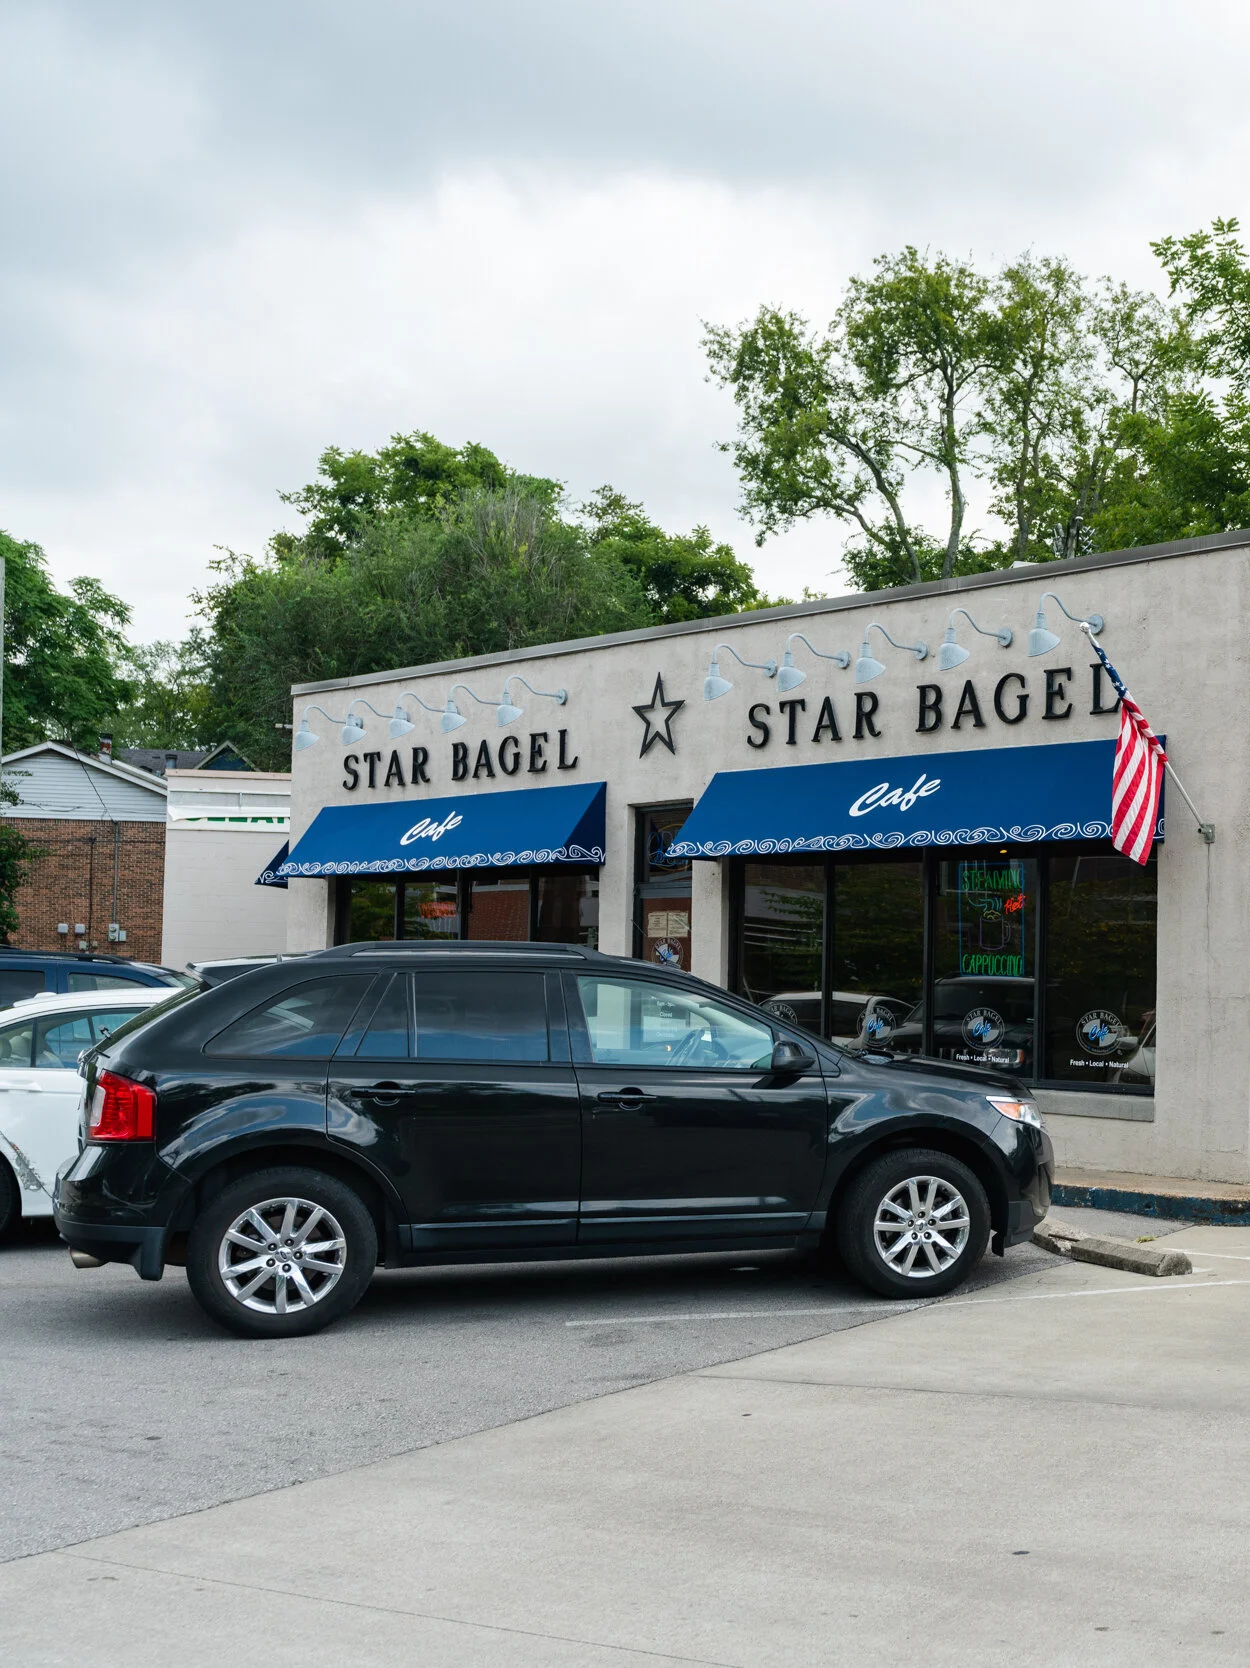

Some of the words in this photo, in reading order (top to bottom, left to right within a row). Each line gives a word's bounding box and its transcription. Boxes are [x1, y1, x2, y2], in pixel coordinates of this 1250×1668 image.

[747, 691, 882, 749] STAR
[915, 662, 1122, 733] BAGEL
[342, 746, 430, 790] STAR
[451, 729, 578, 781] BAGEL
[849, 773, 941, 818] Cafe
[400, 810, 464, 846] Cafe
[962, 954, 1022, 976] CAPPUCCINO
[1081, 1012, 1098, 1025] STAR
[956, 1053, 970, 1061] Fresh
[973, 1054, 987, 1062] Local
[991, 1056, 1010, 1064] Natural
